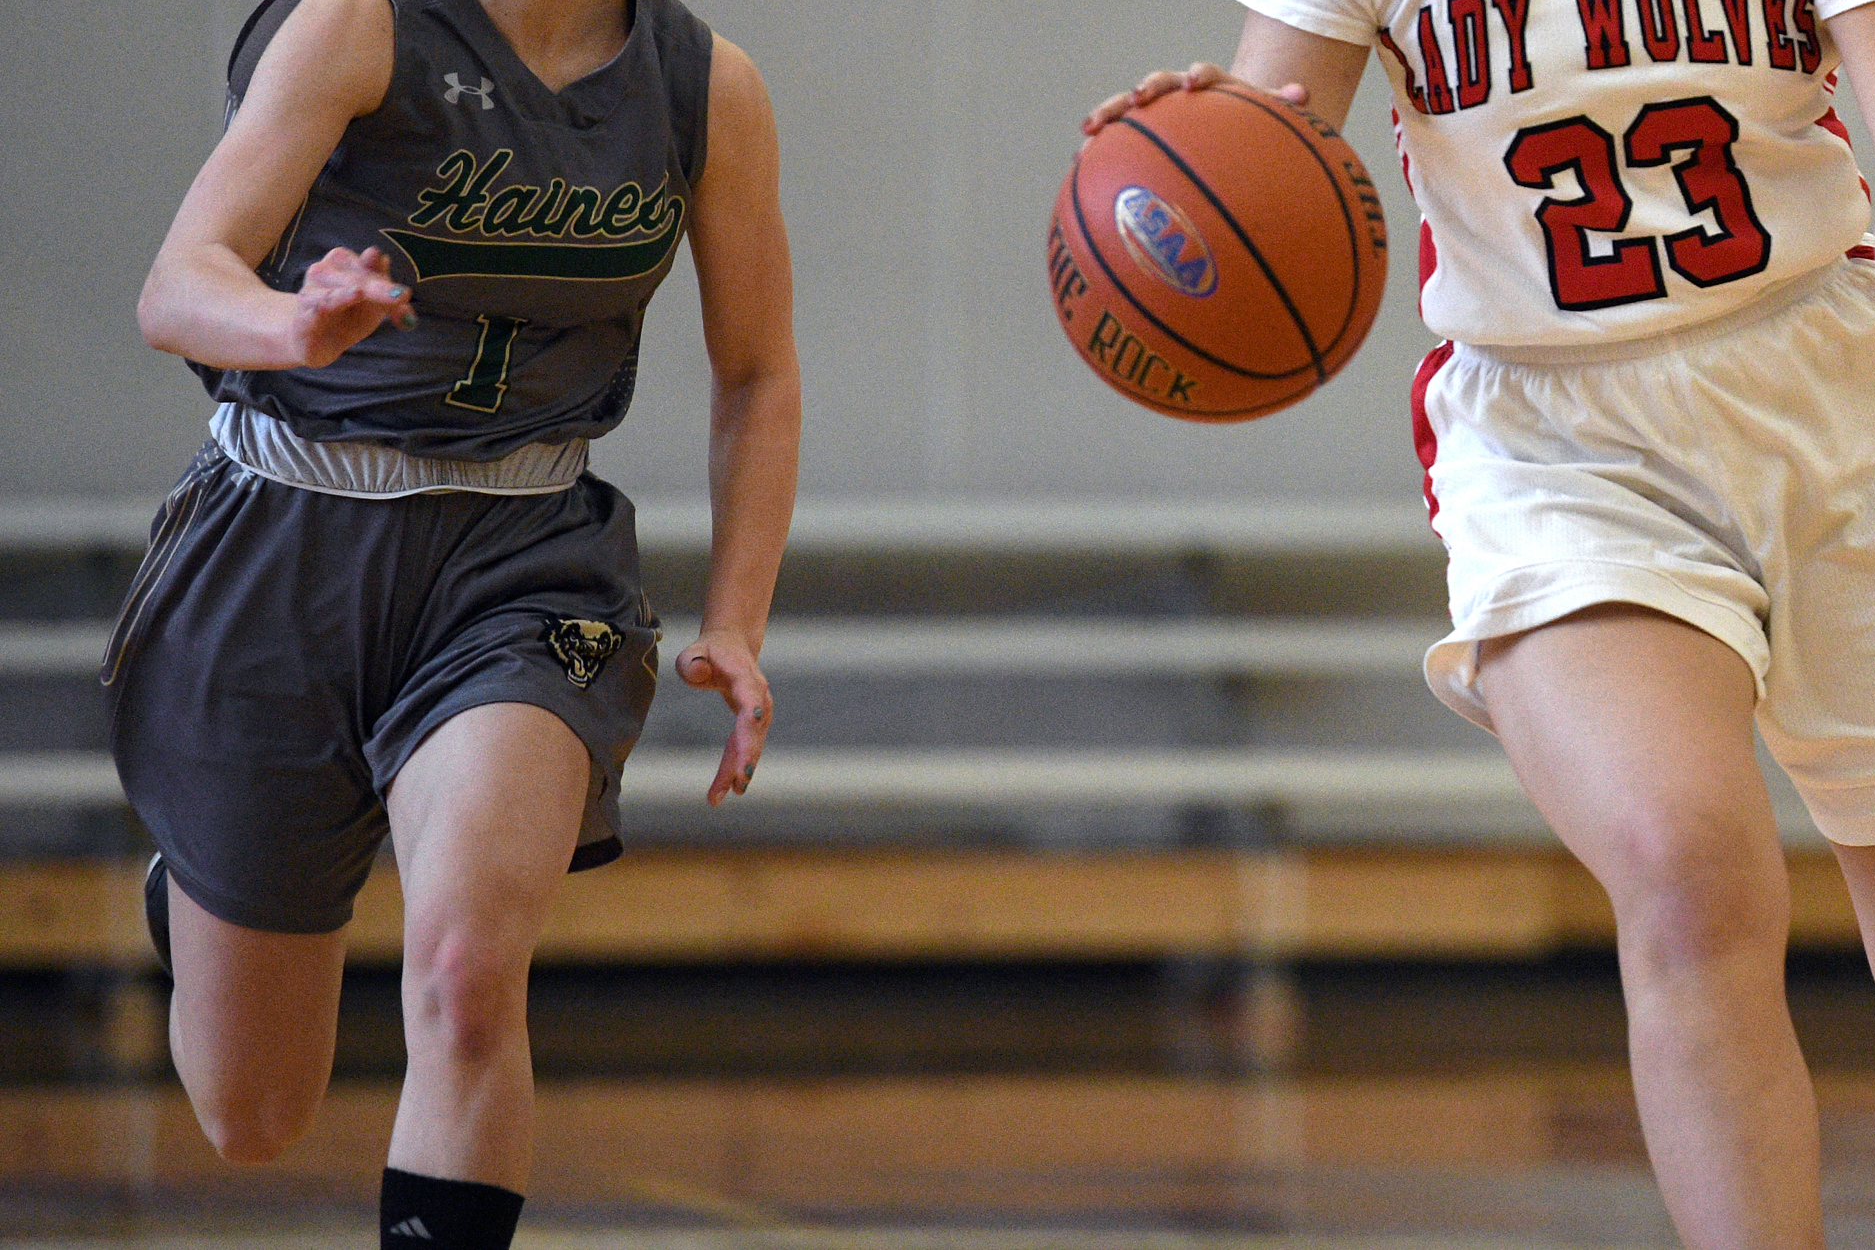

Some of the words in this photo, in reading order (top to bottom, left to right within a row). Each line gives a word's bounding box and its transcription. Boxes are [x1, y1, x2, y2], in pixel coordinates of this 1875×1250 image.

[407, 149, 676, 239] Haines
[1503, 96, 1771, 312] 23
[1088, 311, 1201, 402] ROCK
